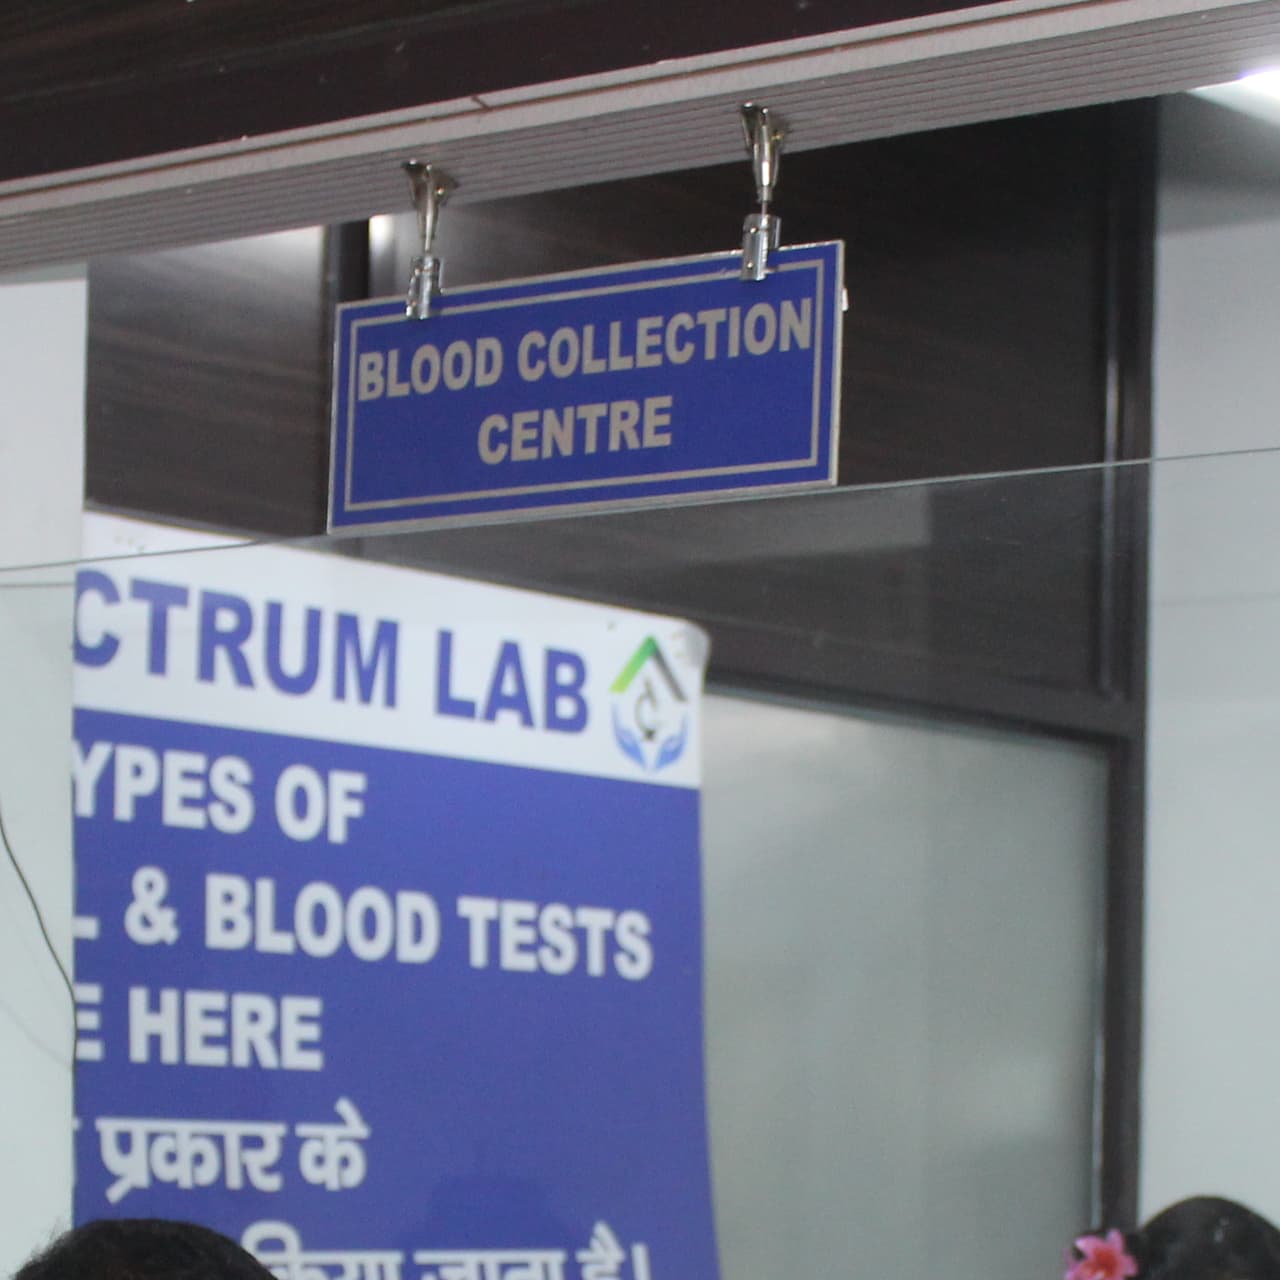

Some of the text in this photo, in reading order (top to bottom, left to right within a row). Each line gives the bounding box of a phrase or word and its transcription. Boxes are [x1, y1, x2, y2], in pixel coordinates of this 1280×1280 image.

[357, 297, 812, 402] BLOOD COLLECTION
[477, 395, 674, 466] CENTRE
[434, 627, 590, 734] LAB
[274, 764, 368, 845] OF
[124, 866, 654, 982] & BLOOD TESTS
[128, 986, 324, 1071] HERE
[94, 1096, 371, 1204] प्रकार के
